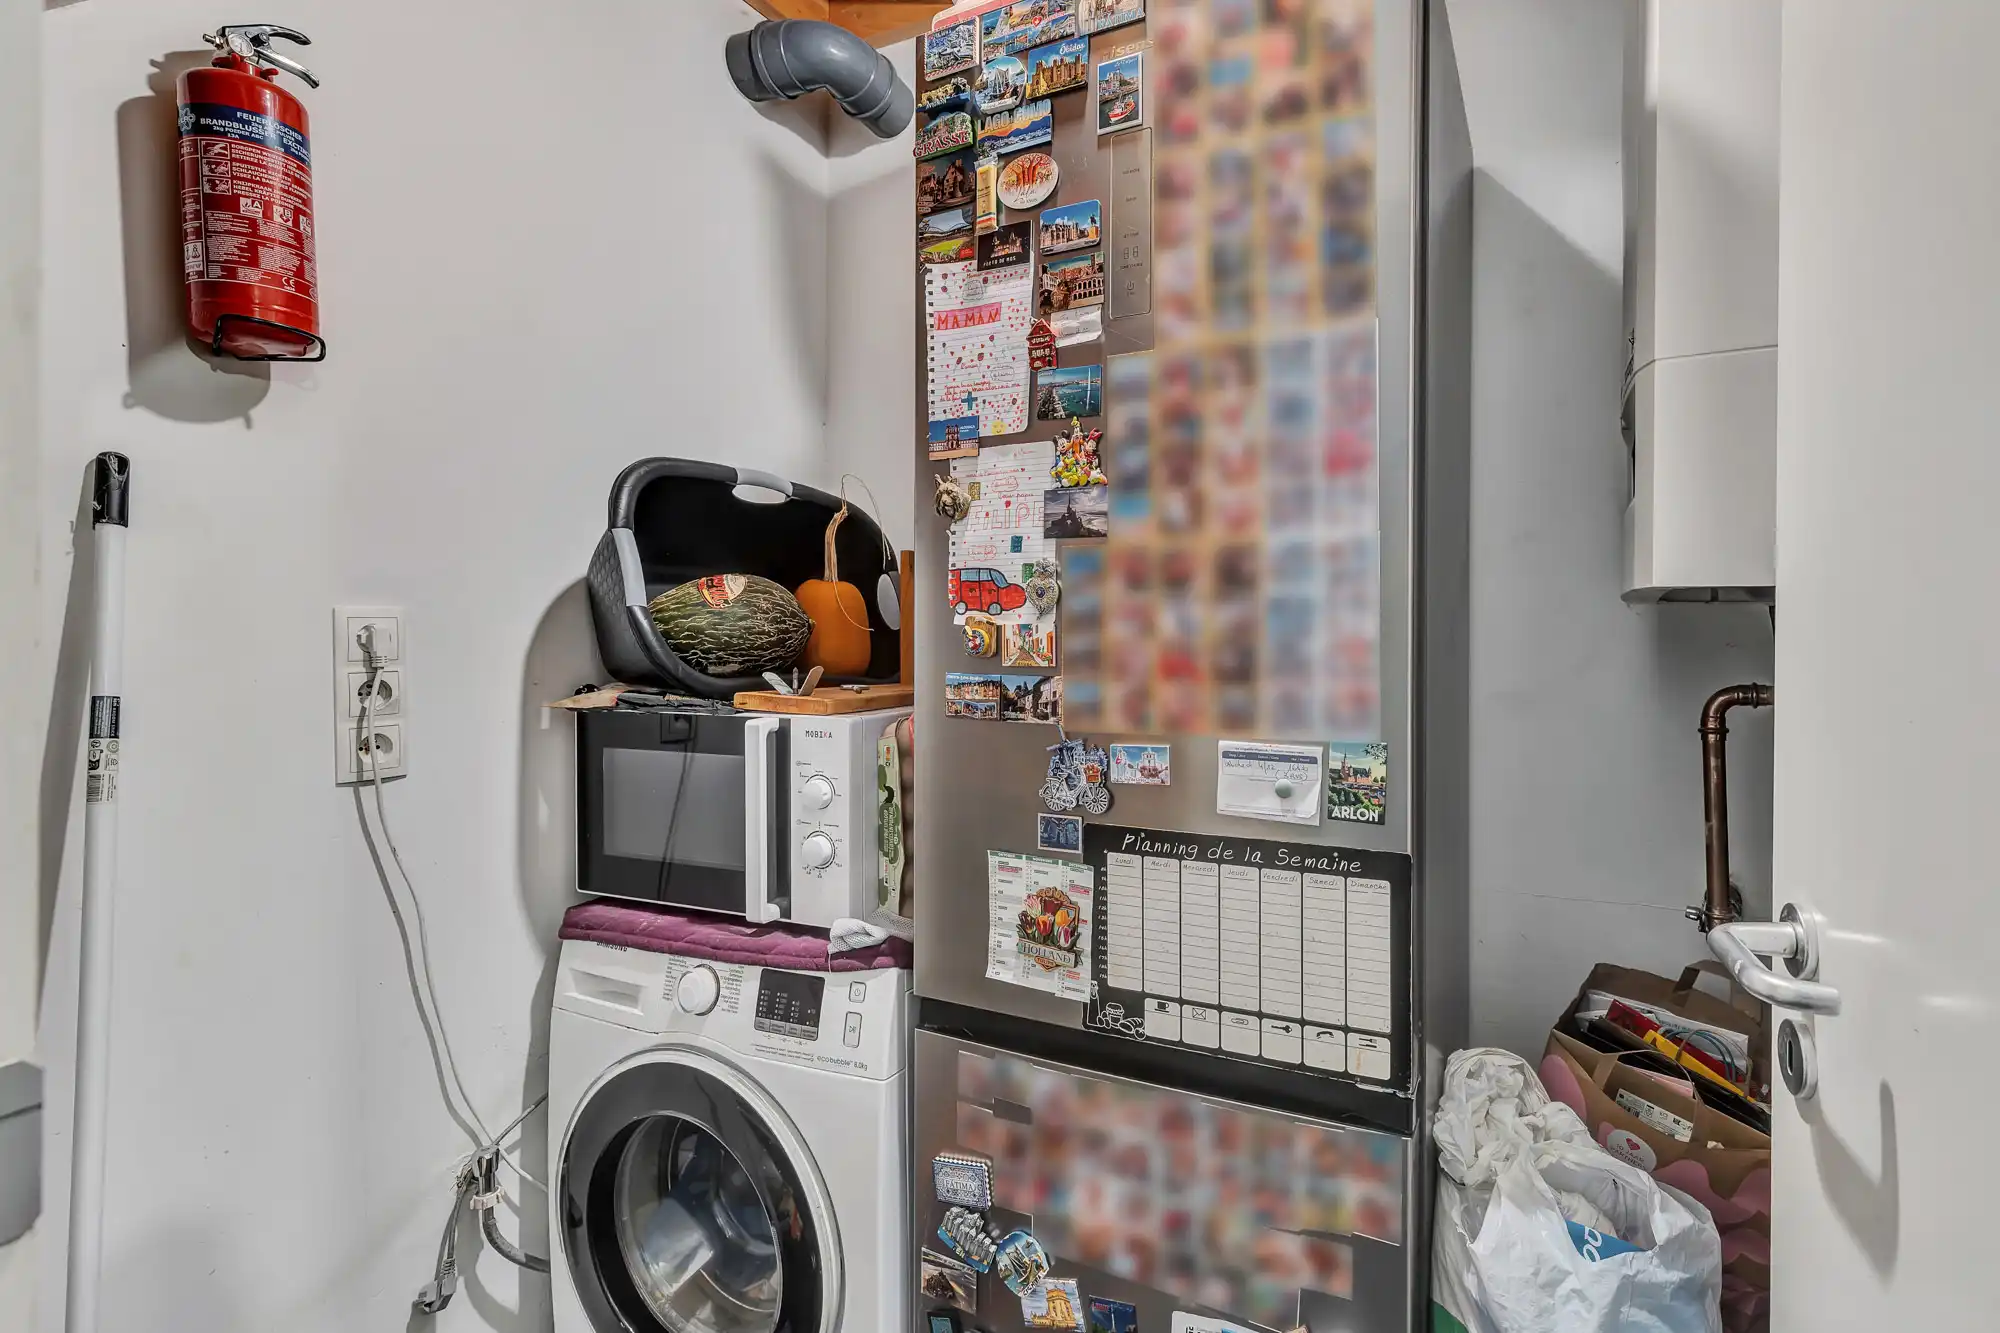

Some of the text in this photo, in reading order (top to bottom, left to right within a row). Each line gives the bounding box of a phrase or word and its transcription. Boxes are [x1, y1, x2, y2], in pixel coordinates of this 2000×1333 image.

[200, 117, 276, 140] BRANDBLUSSER
[913, 130, 971, 159] GRASSE
[937, 307, 999, 330] MAMAN
[805, 729, 833, 739] MOBIKA
[1331, 805, 1379, 823] ARLON
[1122, 831, 1363, 874] Planning de la Semaine
[1227, 868, 1249, 877] Jeudi
[1308, 876, 1339, 887] Samedi
[1023, 942, 1071, 964] HOLLAND
